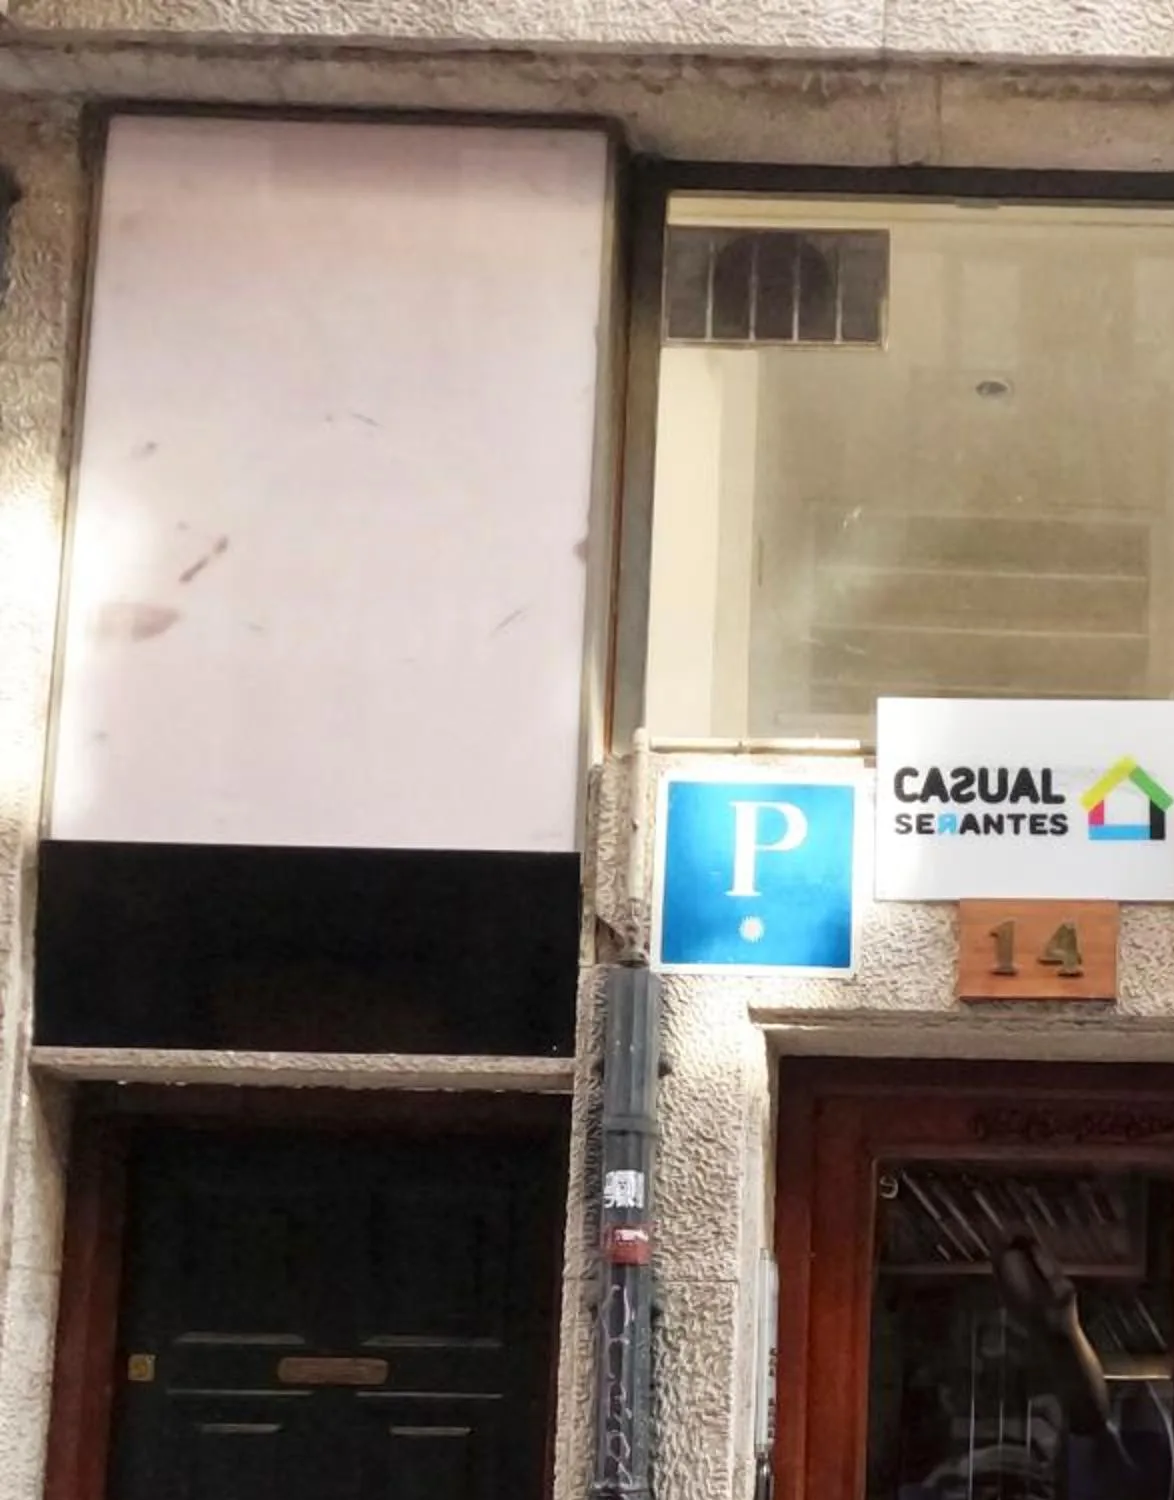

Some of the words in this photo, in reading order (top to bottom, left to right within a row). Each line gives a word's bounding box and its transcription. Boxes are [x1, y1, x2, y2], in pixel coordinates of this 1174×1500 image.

[894, 766, 1066, 804] CASUAL
[724, 800, 808, 897] P
[895, 812, 1069, 836] SERANTES
[988, 918, 1084, 978] 14
